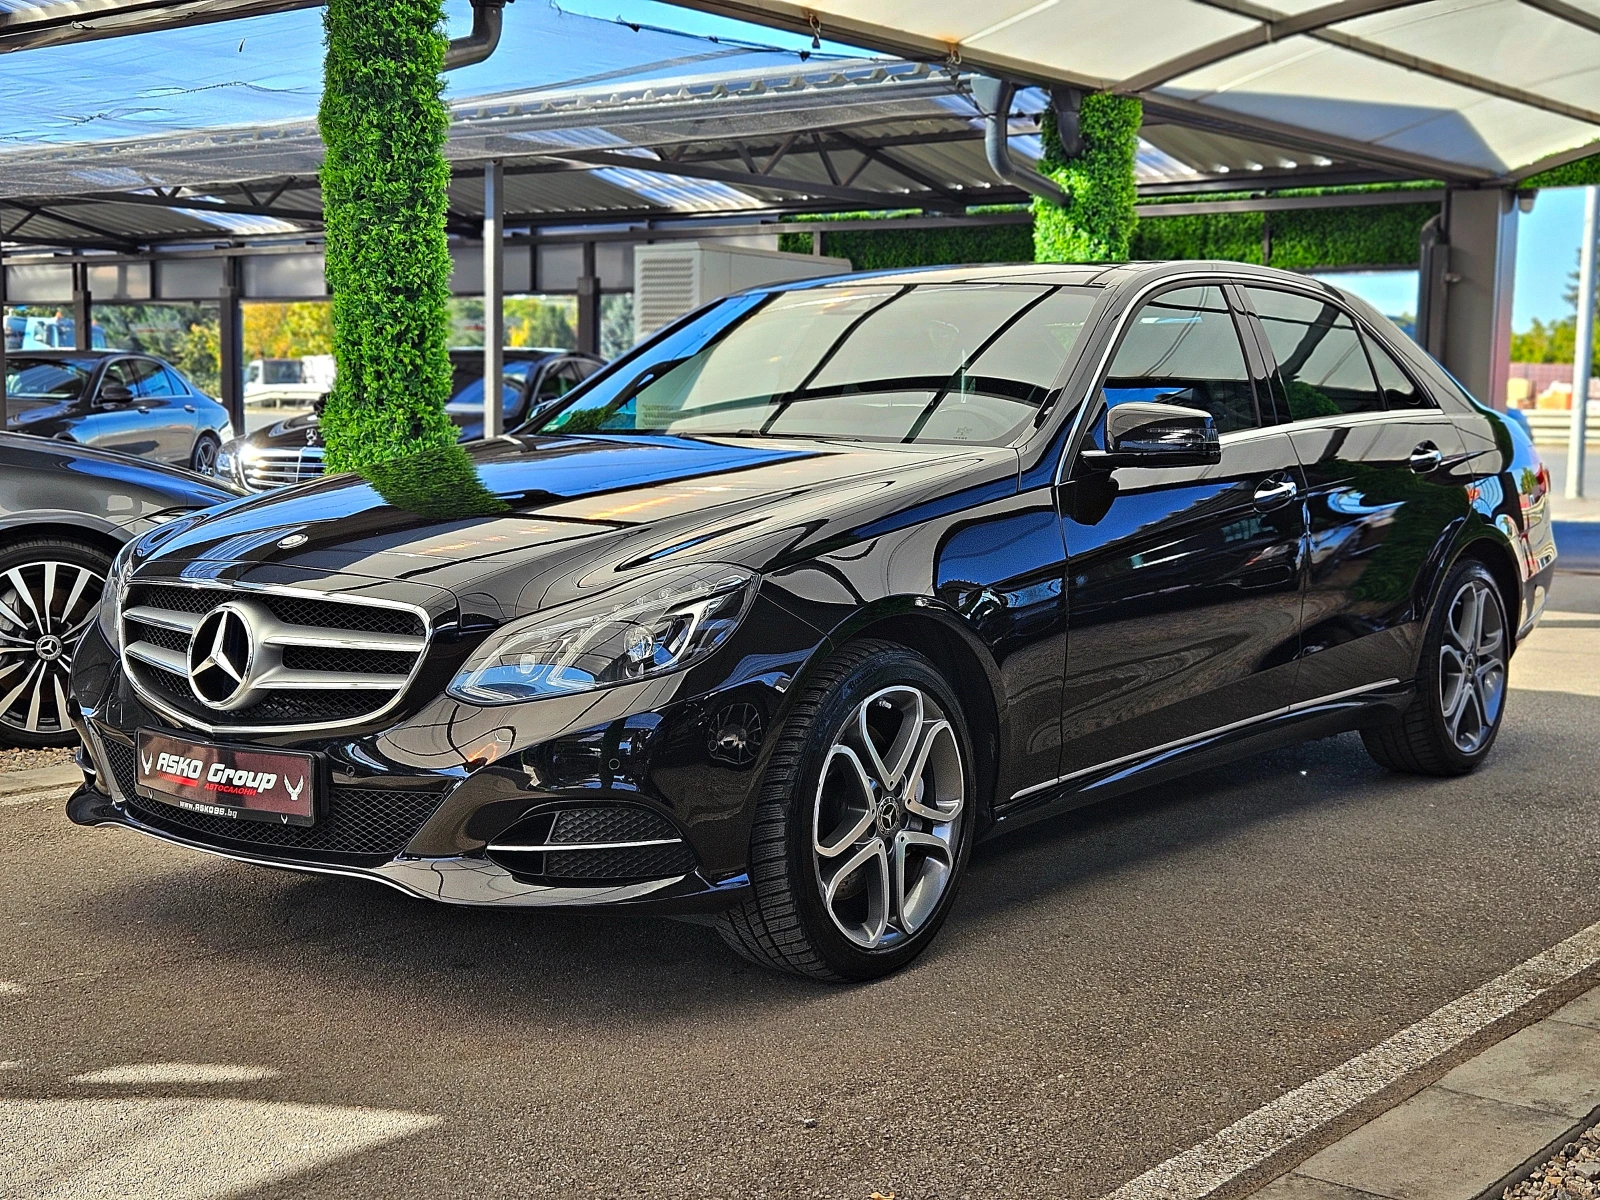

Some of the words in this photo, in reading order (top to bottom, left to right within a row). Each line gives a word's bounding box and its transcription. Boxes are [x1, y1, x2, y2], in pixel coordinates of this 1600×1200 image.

[156, 752, 203, 779] ASKO
[206, 763, 277, 793] Group
[204, 783, 257, 796] АВТОСАЛОНИ
